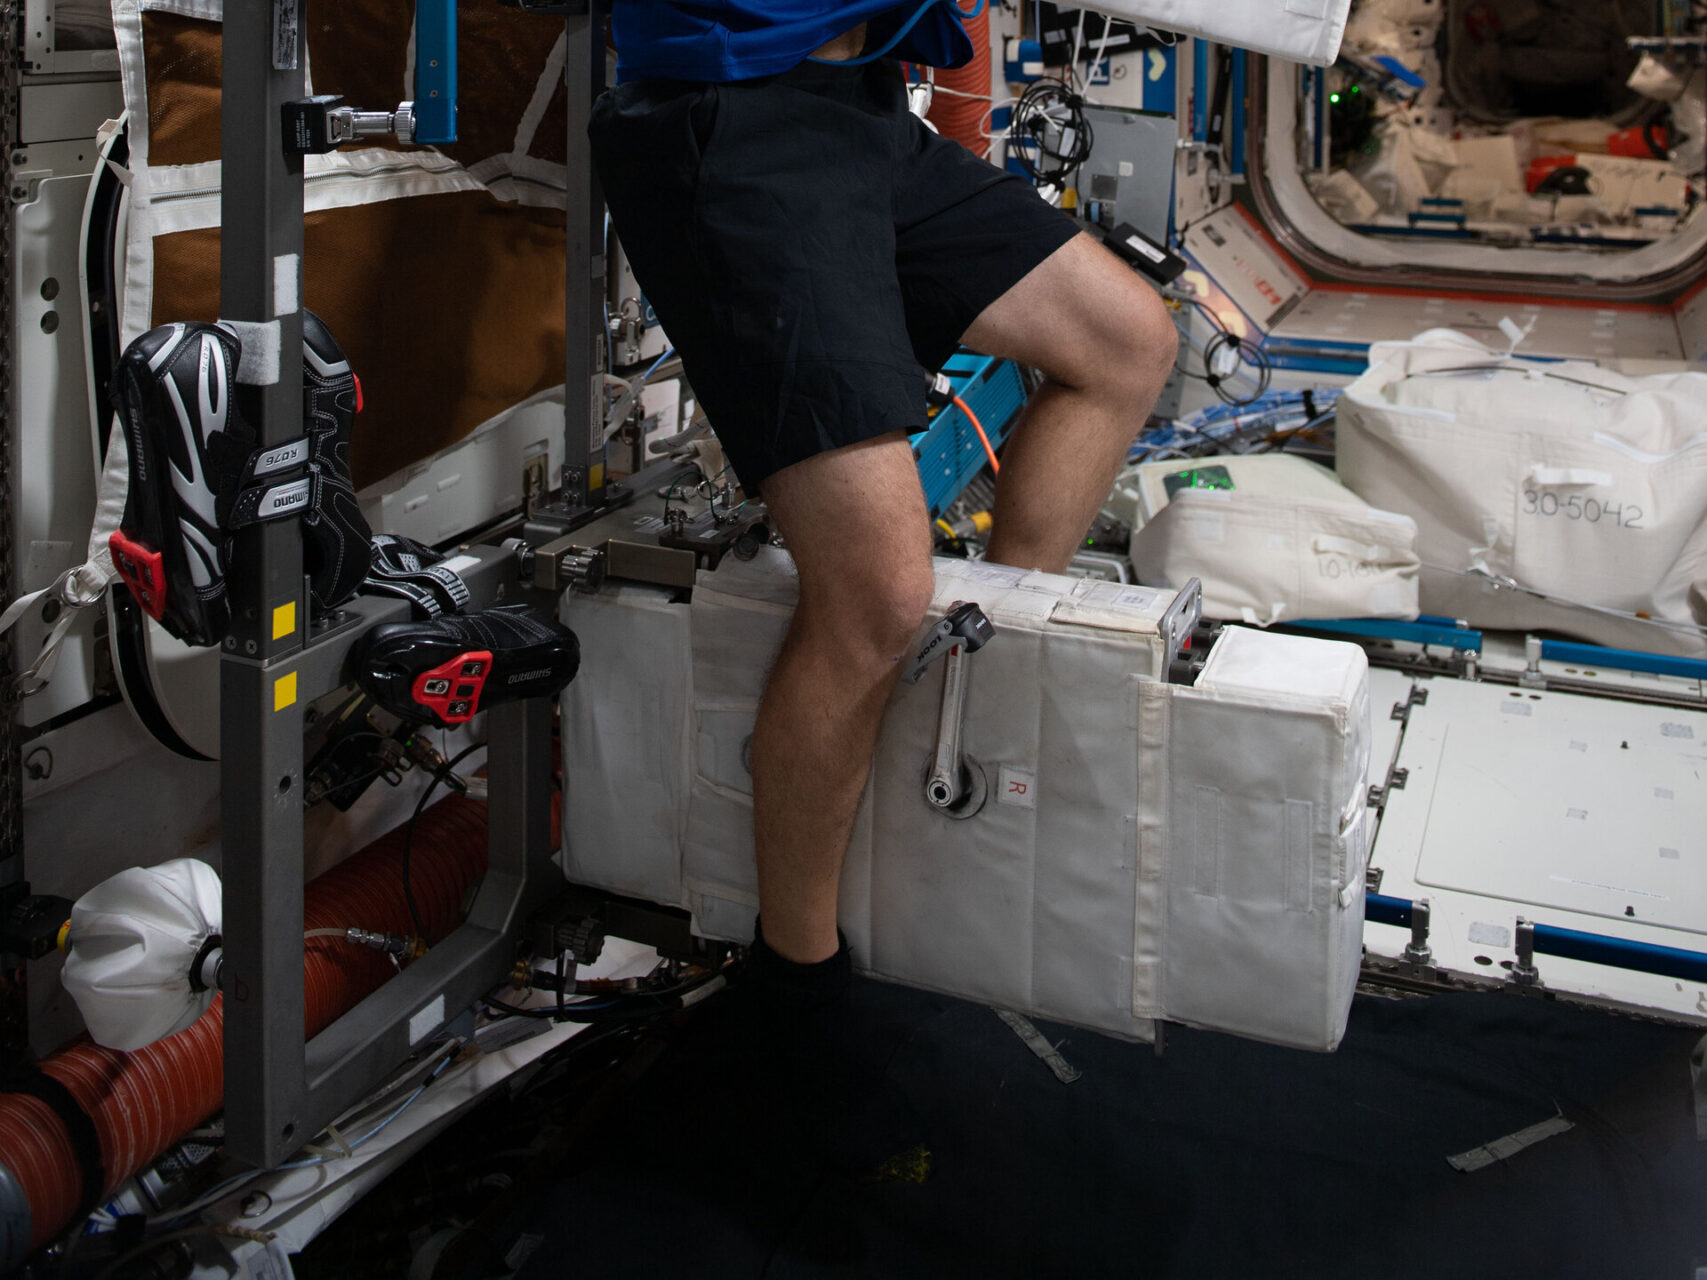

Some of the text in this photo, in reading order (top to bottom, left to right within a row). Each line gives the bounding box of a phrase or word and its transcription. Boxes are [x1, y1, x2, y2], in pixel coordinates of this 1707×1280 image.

[129, 407, 148, 481] SHIMANO
[273, 491, 309, 508] IMANO
[916, 633, 944, 663] LOOK
[507, 666, 552, 685] SHIMANO
[1008, 780, 1028, 795] R
